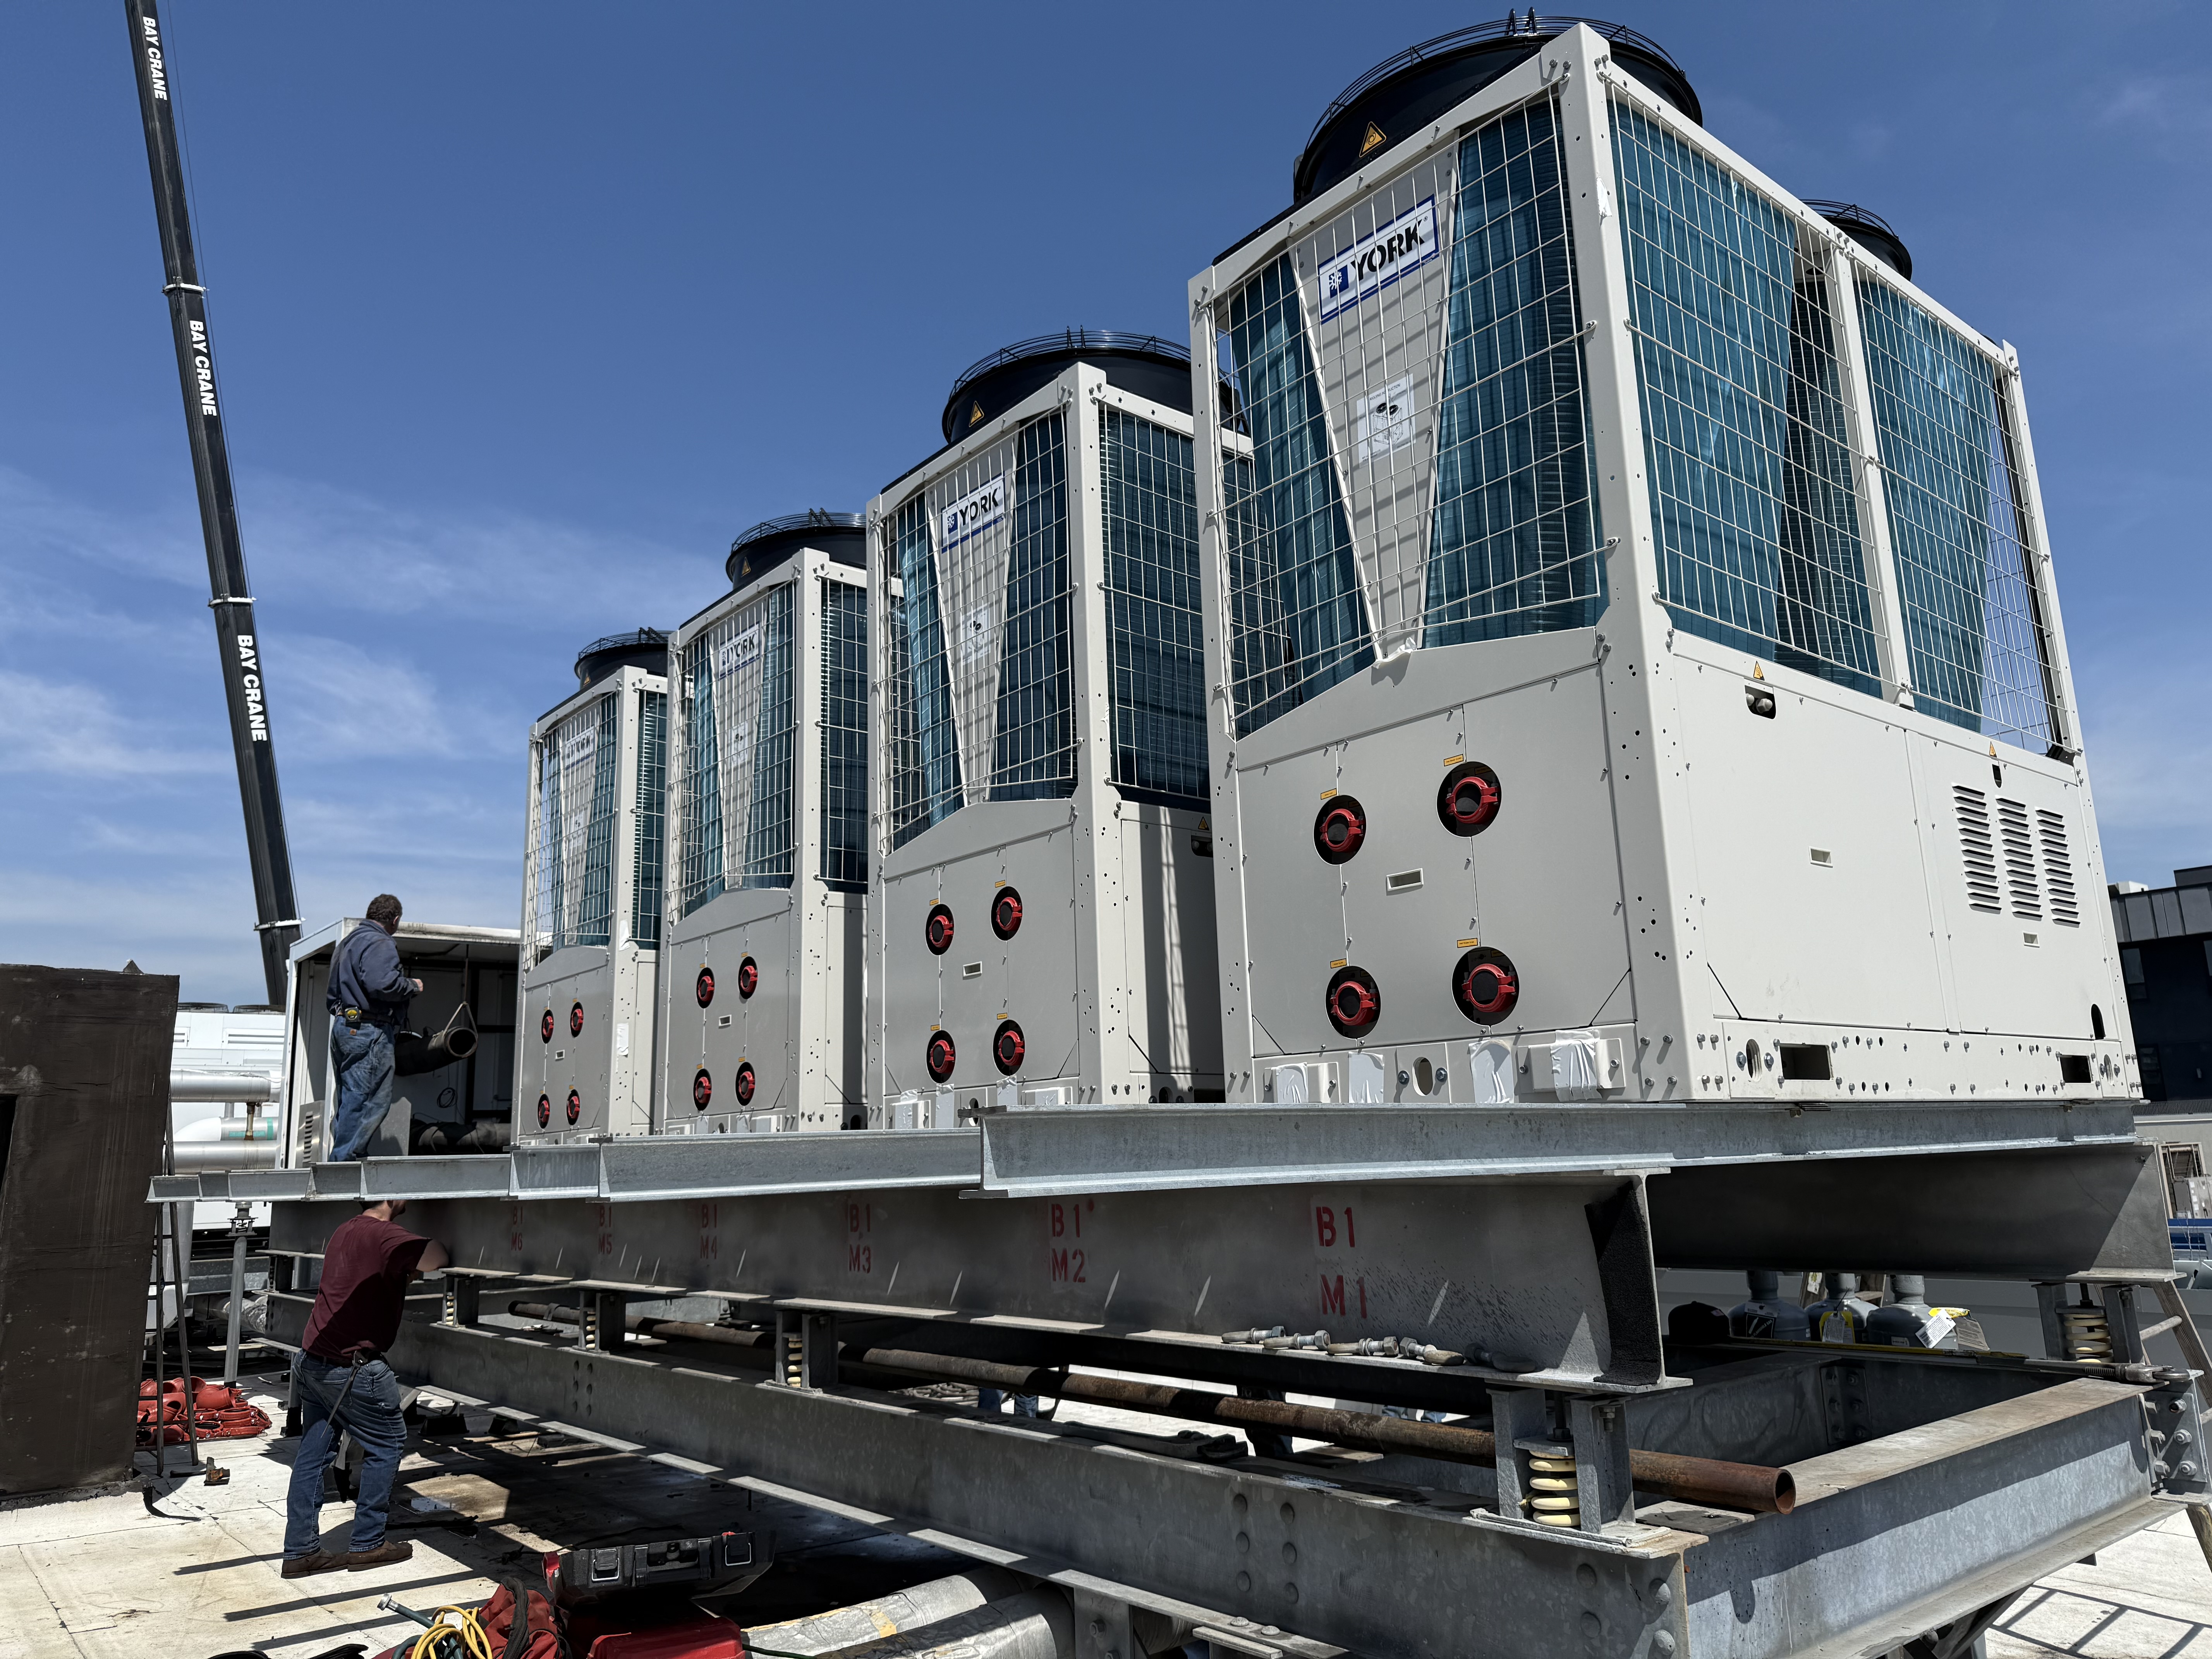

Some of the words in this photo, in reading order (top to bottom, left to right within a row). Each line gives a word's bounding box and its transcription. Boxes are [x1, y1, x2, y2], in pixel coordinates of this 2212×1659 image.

[143, 16, 159, 46] BAY
[148, 47, 167, 100] CRANE
[190, 320, 208, 353] BAY
[195, 356, 217, 416] CRANE
[959, 488, 999, 526] YORK
[237, 635, 257, 670] BAY
[730, 634, 755, 661] YORK
[244, 674, 267, 742] CRANE
[599, 1206, 612, 1227] B1
[701, 1204, 717, 1228] B1
[850, 1204, 871, 1232] B1
[1051, 1204, 1080, 1238] B1
[1316, 1206, 1355, 1248] B1
[598, 1234, 612, 1255] M5
[700, 1235, 717, 1259] M4
[849, 1244, 871, 1274] M3
[1052, 1248, 1086, 1283] M2
[1321, 1274, 1367, 1319] M1
